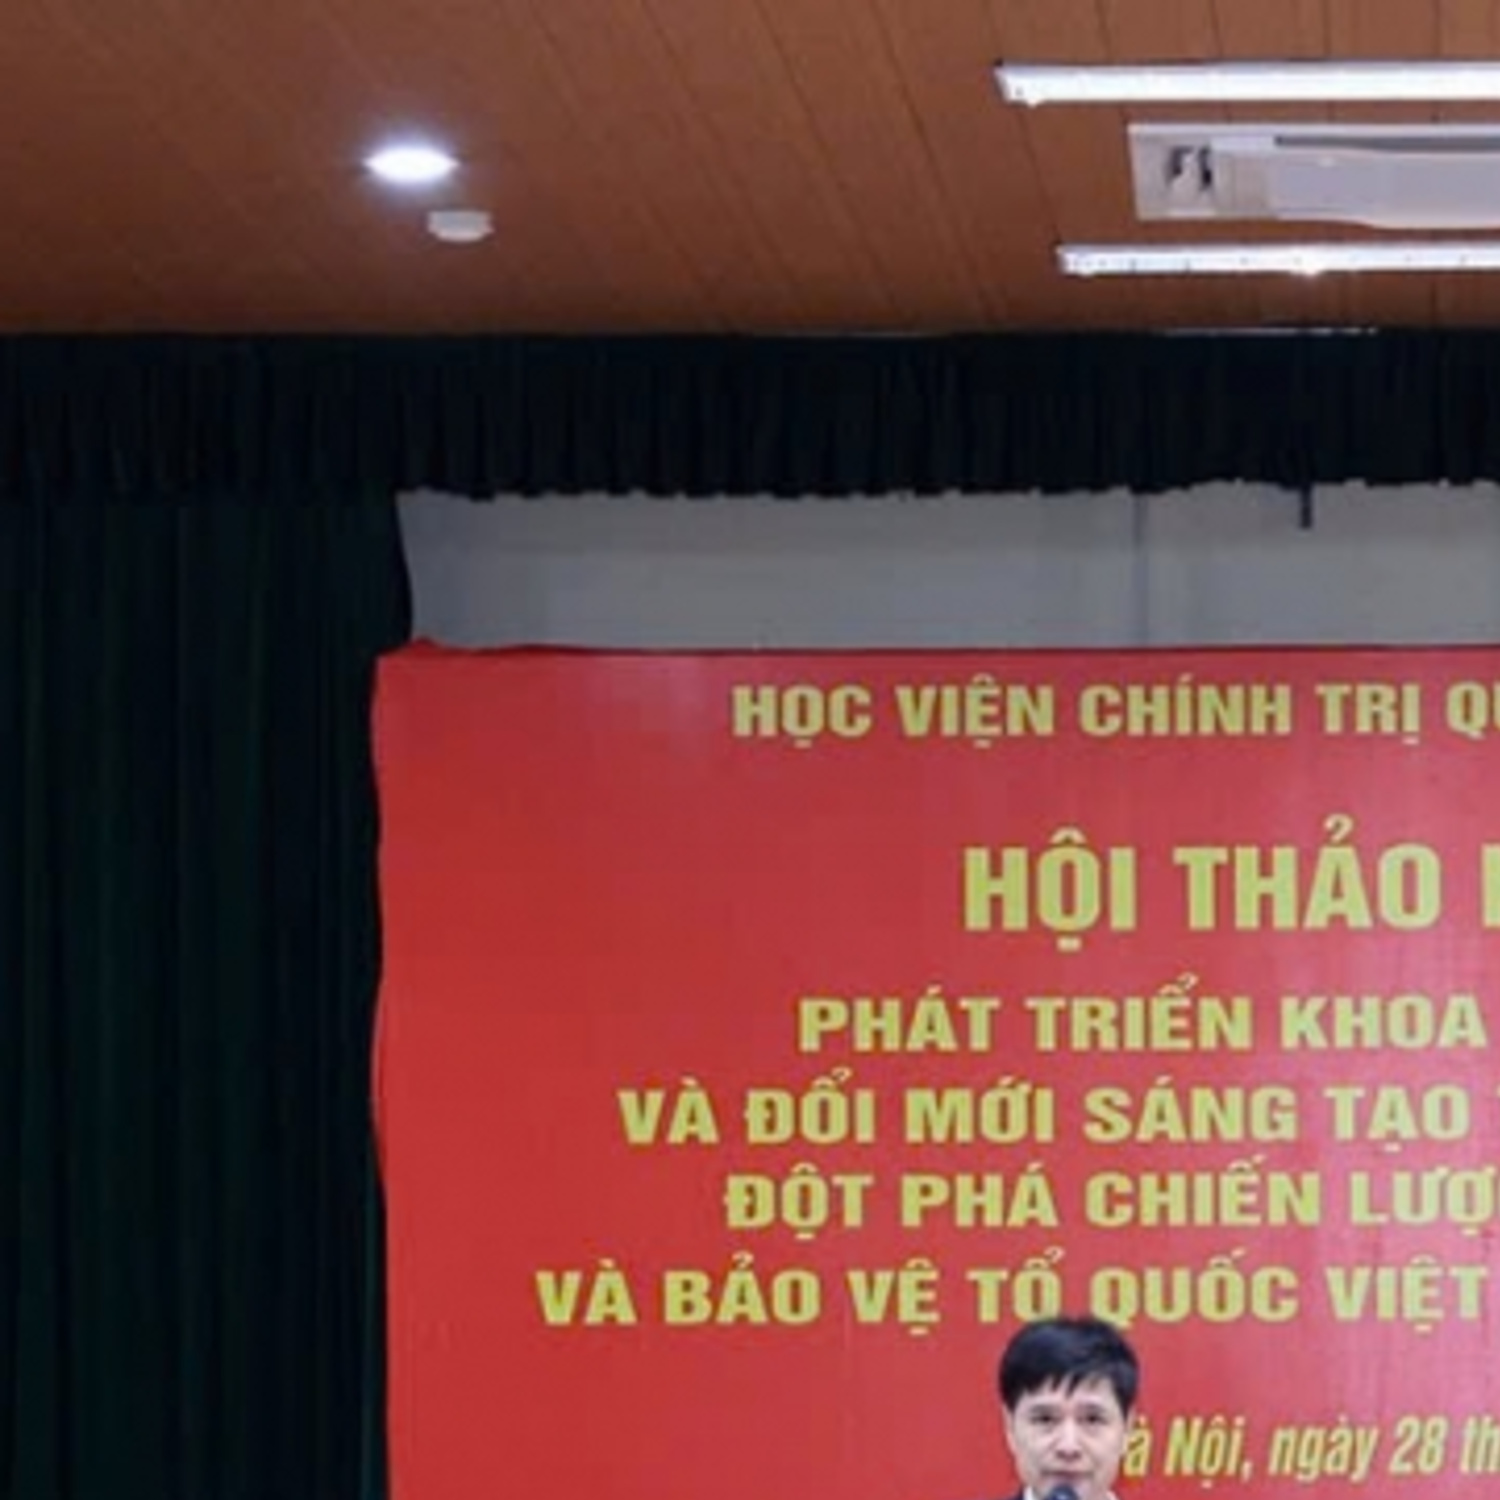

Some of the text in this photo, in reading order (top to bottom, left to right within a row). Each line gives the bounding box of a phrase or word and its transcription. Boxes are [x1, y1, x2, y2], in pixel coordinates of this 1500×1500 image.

[732, 683, 873, 748] HỌC
[897, 673, 1056, 748] VIỆN
[1079, 672, 1292, 737] CHÍNH
[1315, 683, 1421, 745] TRỊ
[963, 827, 1137, 951] HỘI
[1173, 814, 1441, 931] THẢO
[797, 985, 1000, 1053] PHÁT
[1026, 973, 1254, 1052] TRIỂN
[1281, 995, 1488, 1048] KHOA
[617, 1076, 719, 1146] VÀ
[743, 1066, 876, 1145] ĐỔI
[904, 1077, 1056, 1144] MỚI
[1083, 1077, 1298, 1143] SÁNG
[1323, 1084, 1471, 1153] TẠO
[723, 1163, 874, 1241] ĐỘT
[900, 1163, 1058, 1229] PHÁ
[1083, 1155, 1322, 1228] CHIẾN
[535, 1257, 638, 1327] VÀ
[663, 1252, 822, 1326] BẢO
[845, 1257, 941, 1335] VỆ
[966, 1247, 1064, 1323] TỔ
[1090, 1247, 1300, 1330] QUỐC
[1325, 1254, 1489, 1333] VIỆT
[1122, 1414, 1152, 1477] à
[1164, 1410, 1253, 1488] Nội,
[1267, 1416, 1379, 1481] ngày
[1388, 1415, 1447, 1473] 28
